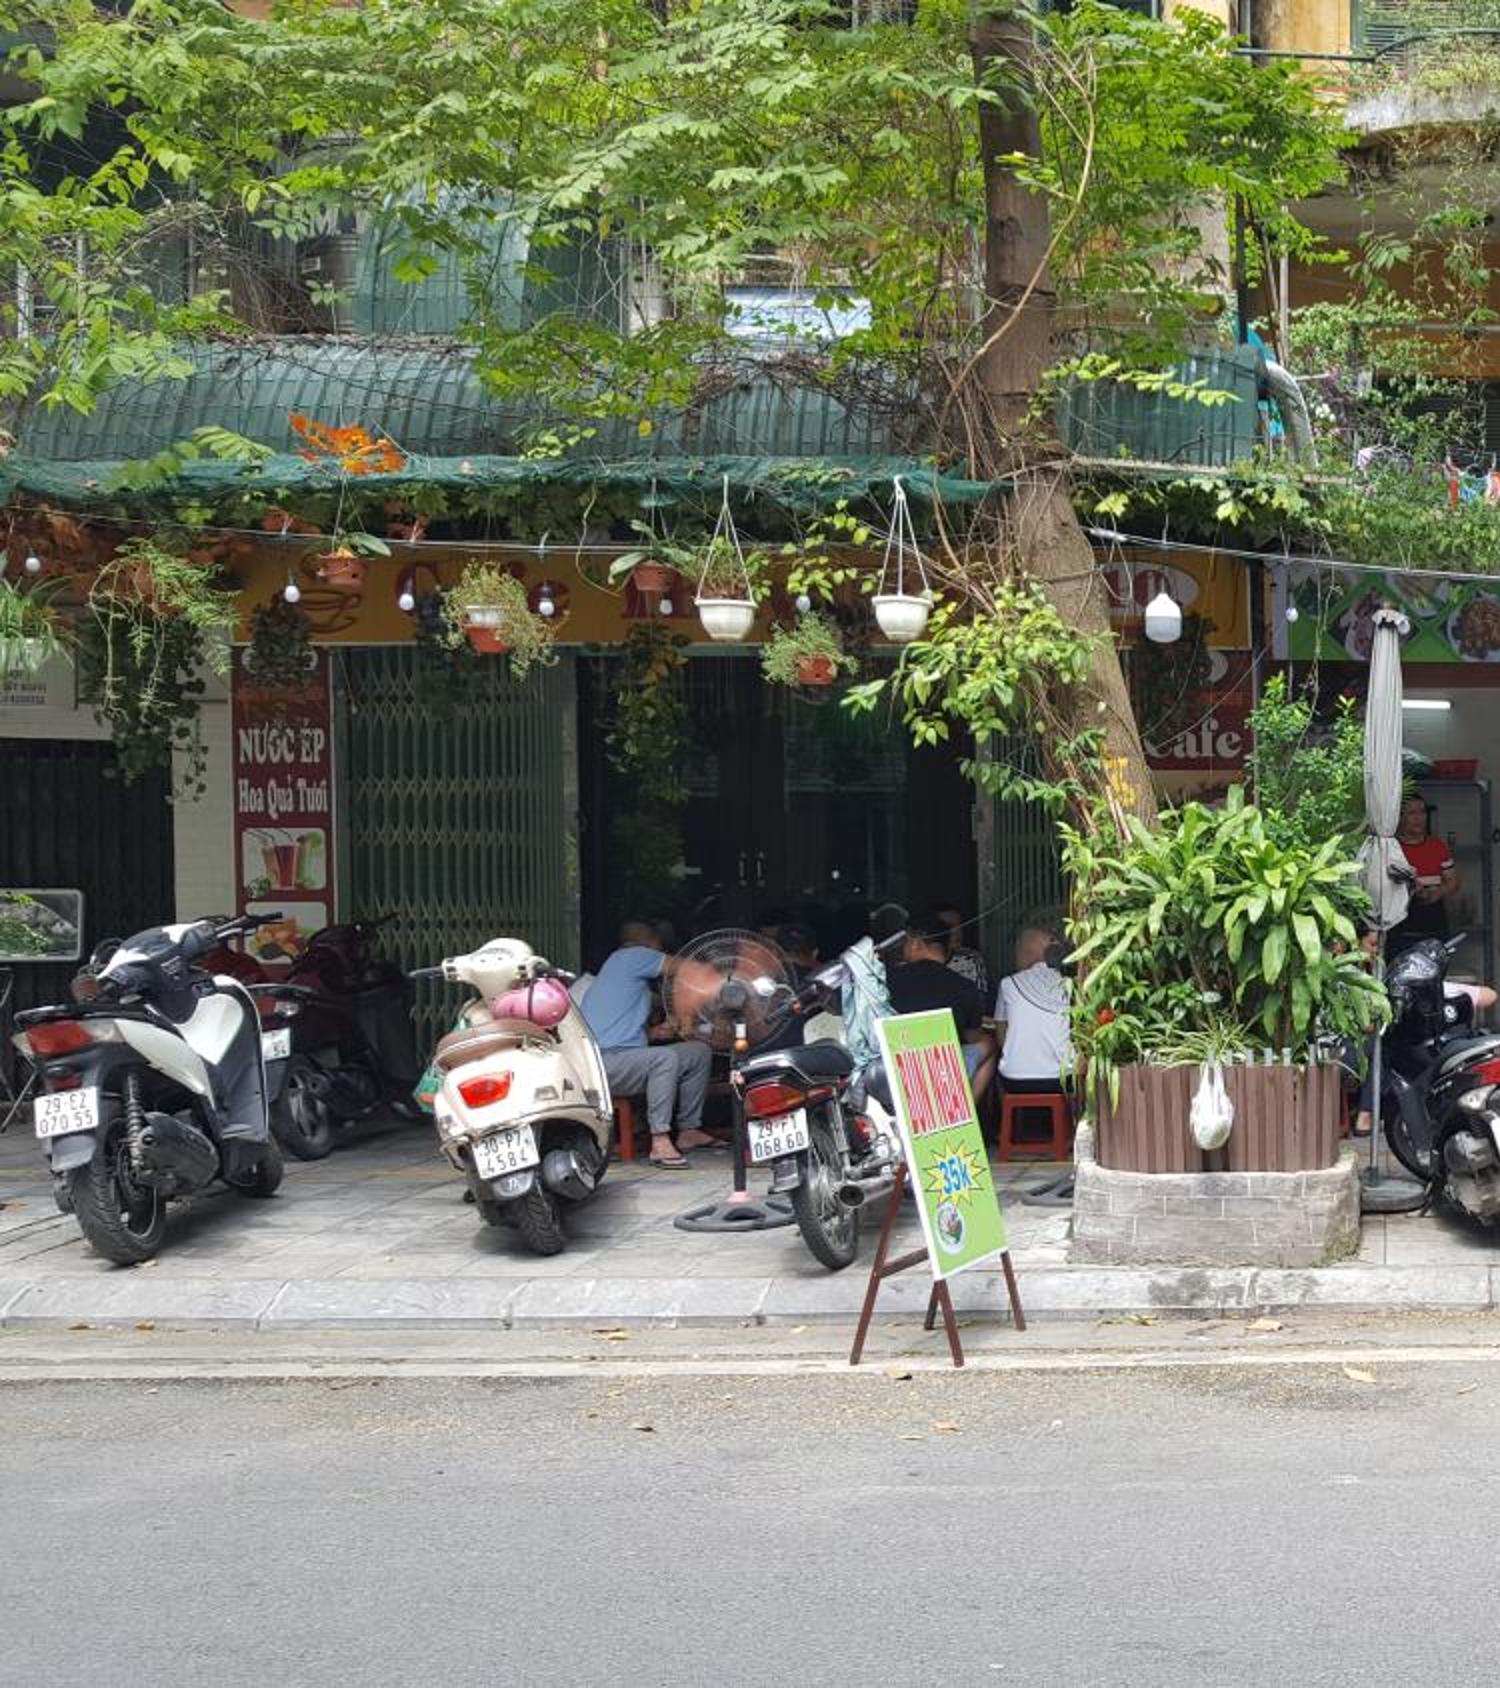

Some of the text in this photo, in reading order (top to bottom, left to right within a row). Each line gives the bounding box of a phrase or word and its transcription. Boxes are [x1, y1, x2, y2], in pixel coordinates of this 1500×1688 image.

[239, 778, 264, 813] Hoa
[267, 774, 294, 820] Quả
[938, 1155, 971, 1195] 35k
